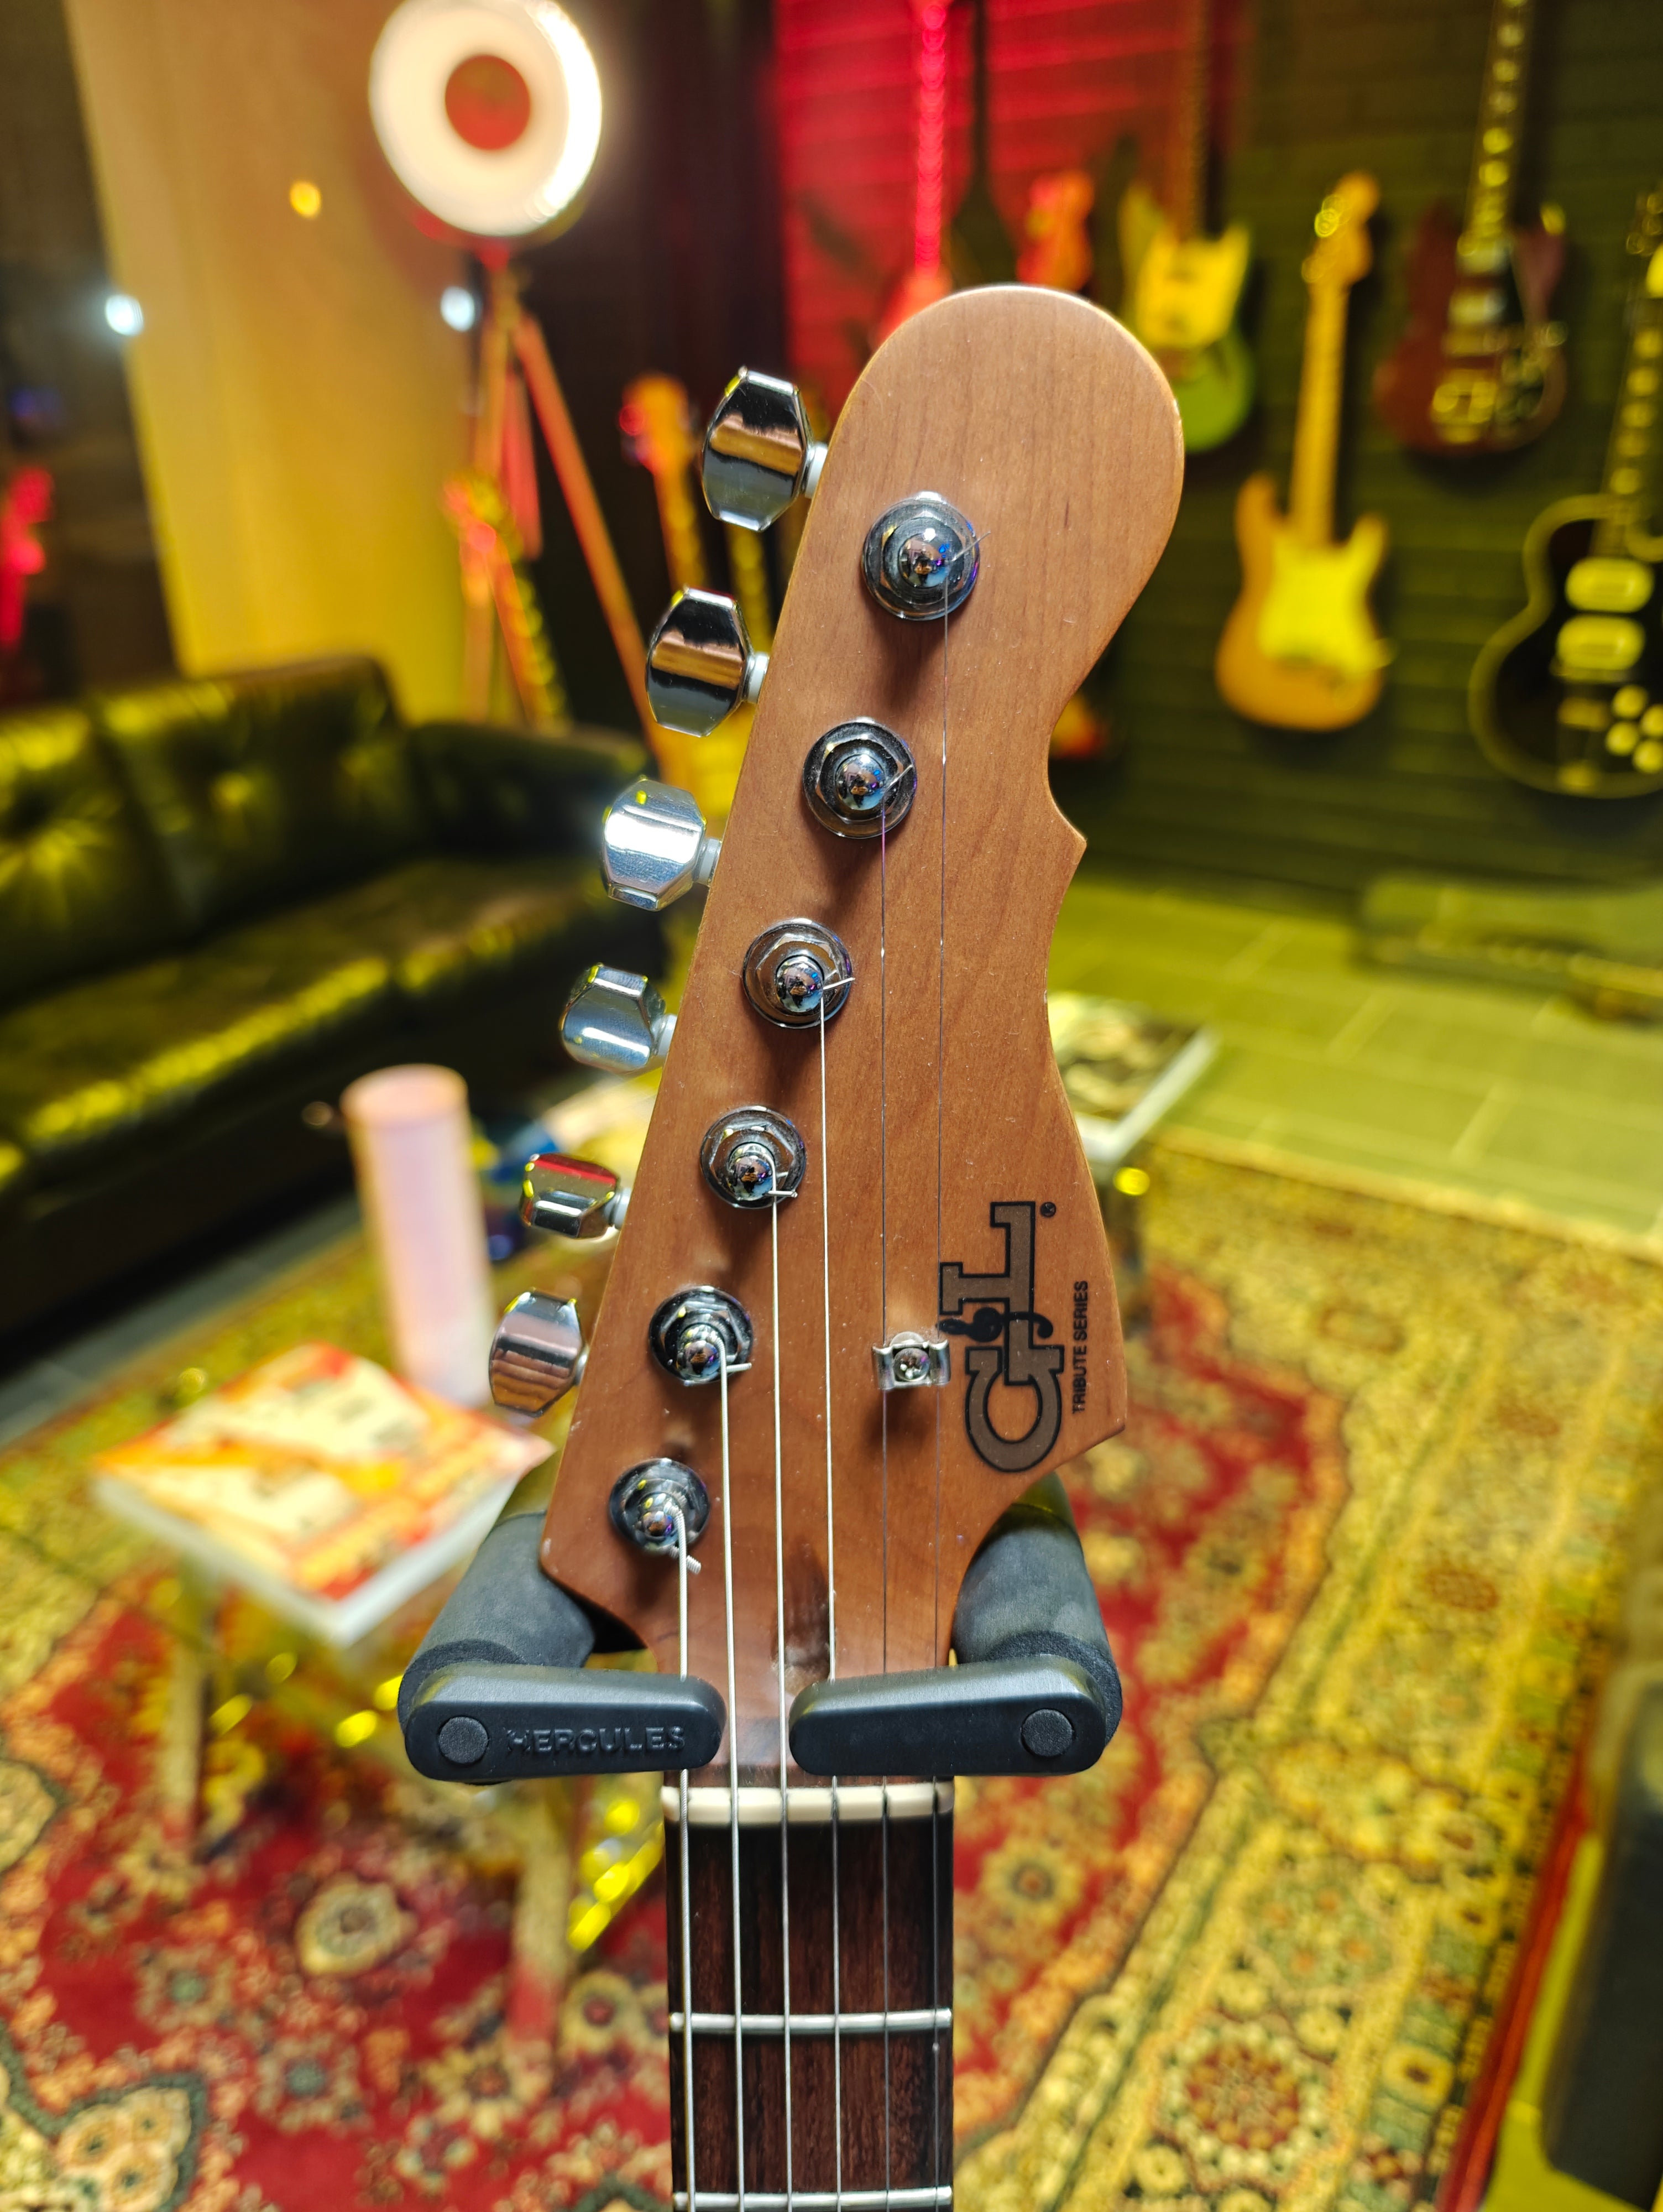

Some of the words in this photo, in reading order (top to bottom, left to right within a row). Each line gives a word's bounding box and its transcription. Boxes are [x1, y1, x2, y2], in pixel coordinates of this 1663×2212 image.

[1073, 1280, 1089, 1340] SERIES
[1072, 1345, 1087, 1414] TRIBUTE
[506, 1726, 685, 1753] HERCULES
